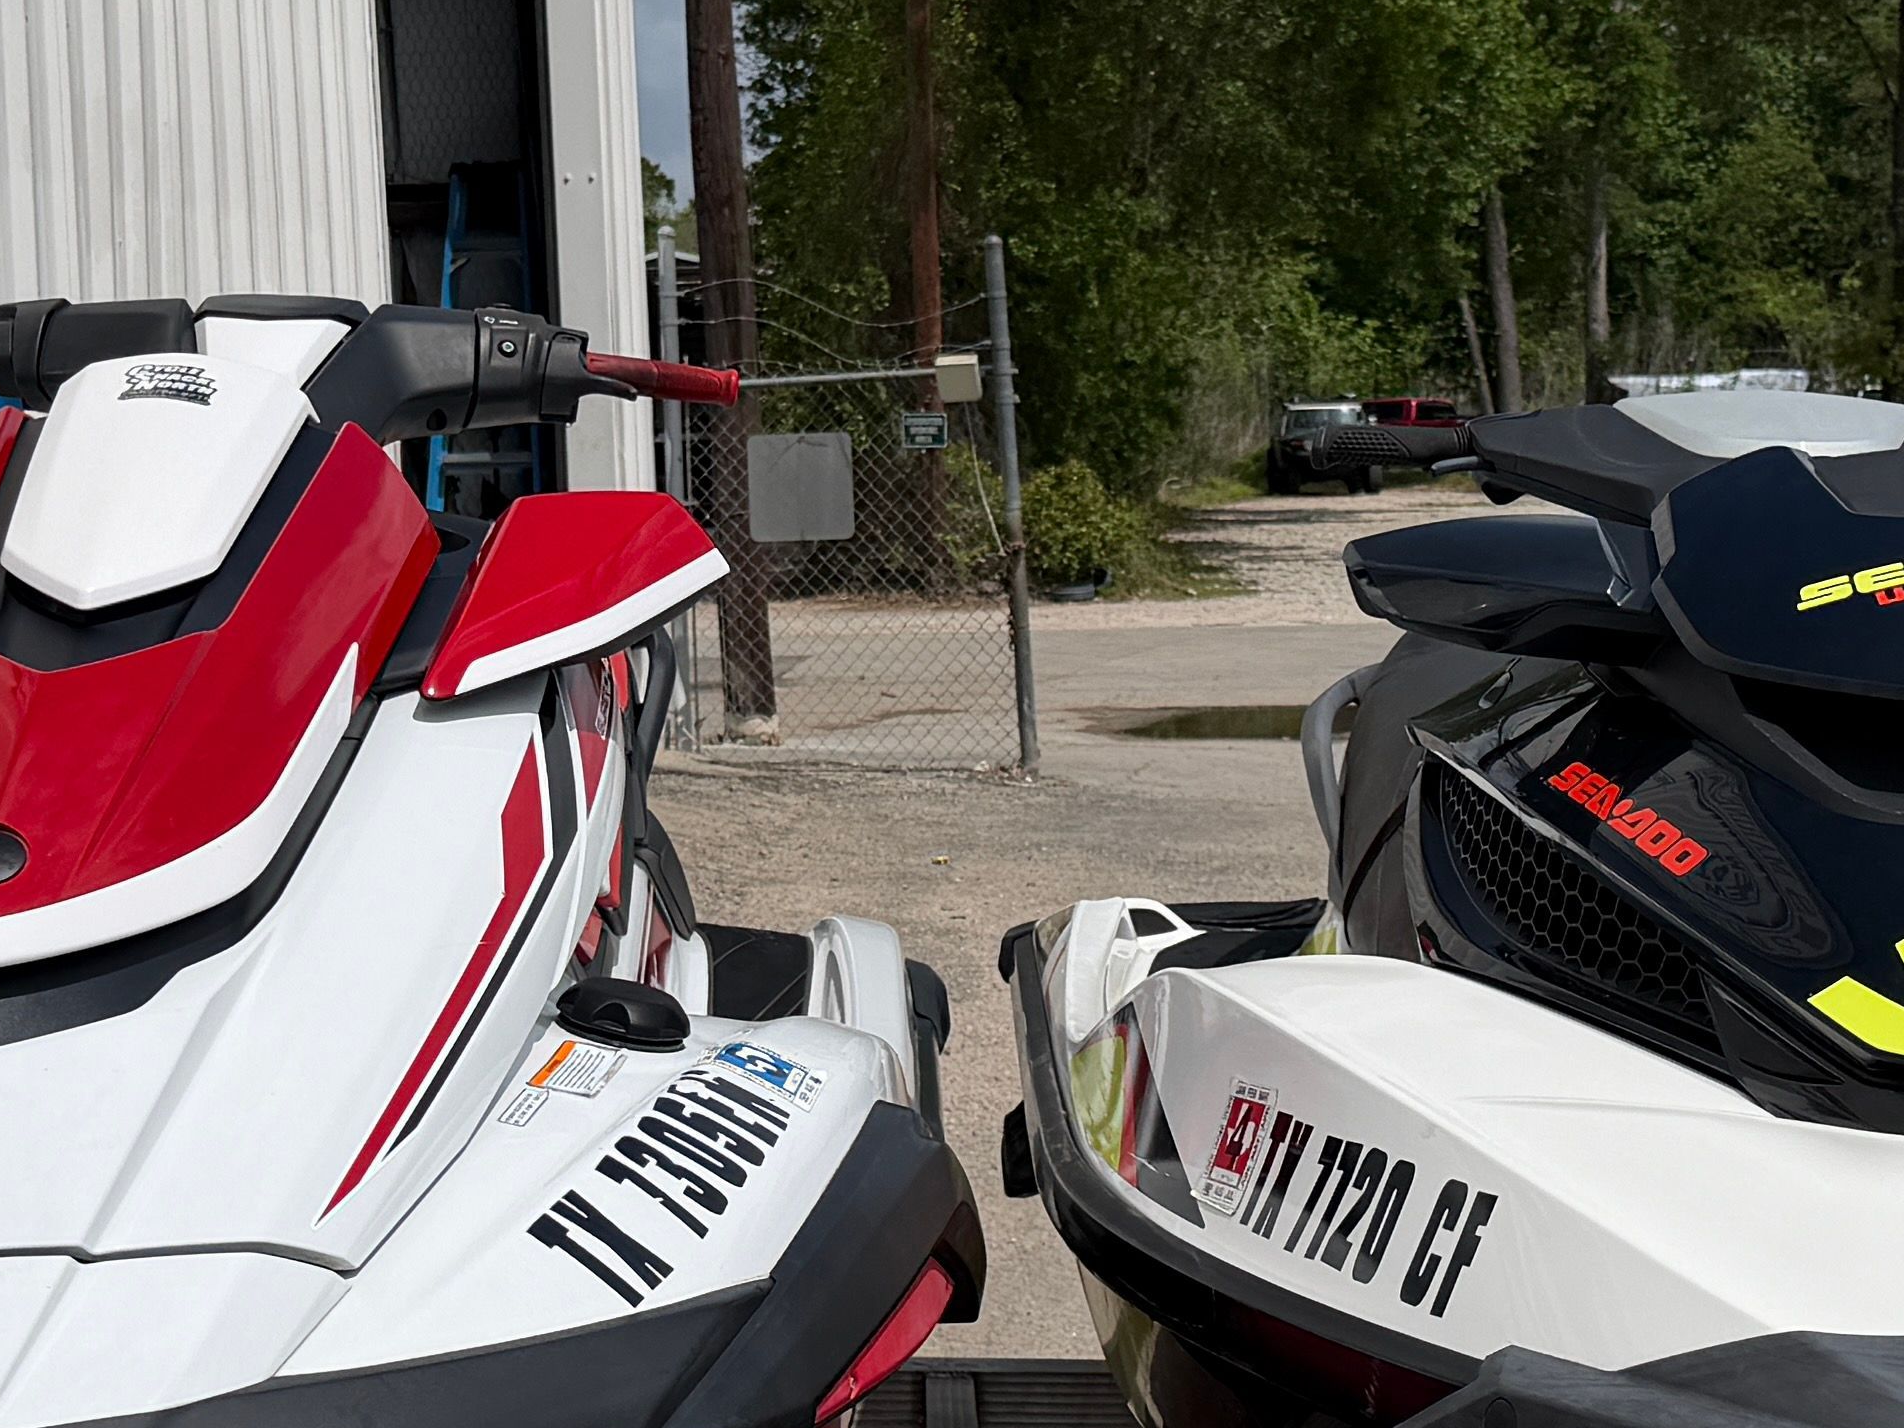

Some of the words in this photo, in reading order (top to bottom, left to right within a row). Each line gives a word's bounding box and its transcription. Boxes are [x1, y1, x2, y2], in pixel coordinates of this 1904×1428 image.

[130, 379, 218, 396] NORTH
[1225, 1104, 1255, 1173] 4
[526, 1189, 674, 1308] TX
[1239, 1110, 1315, 1240] TX
[1399, 1178, 1499, 1319] CF
